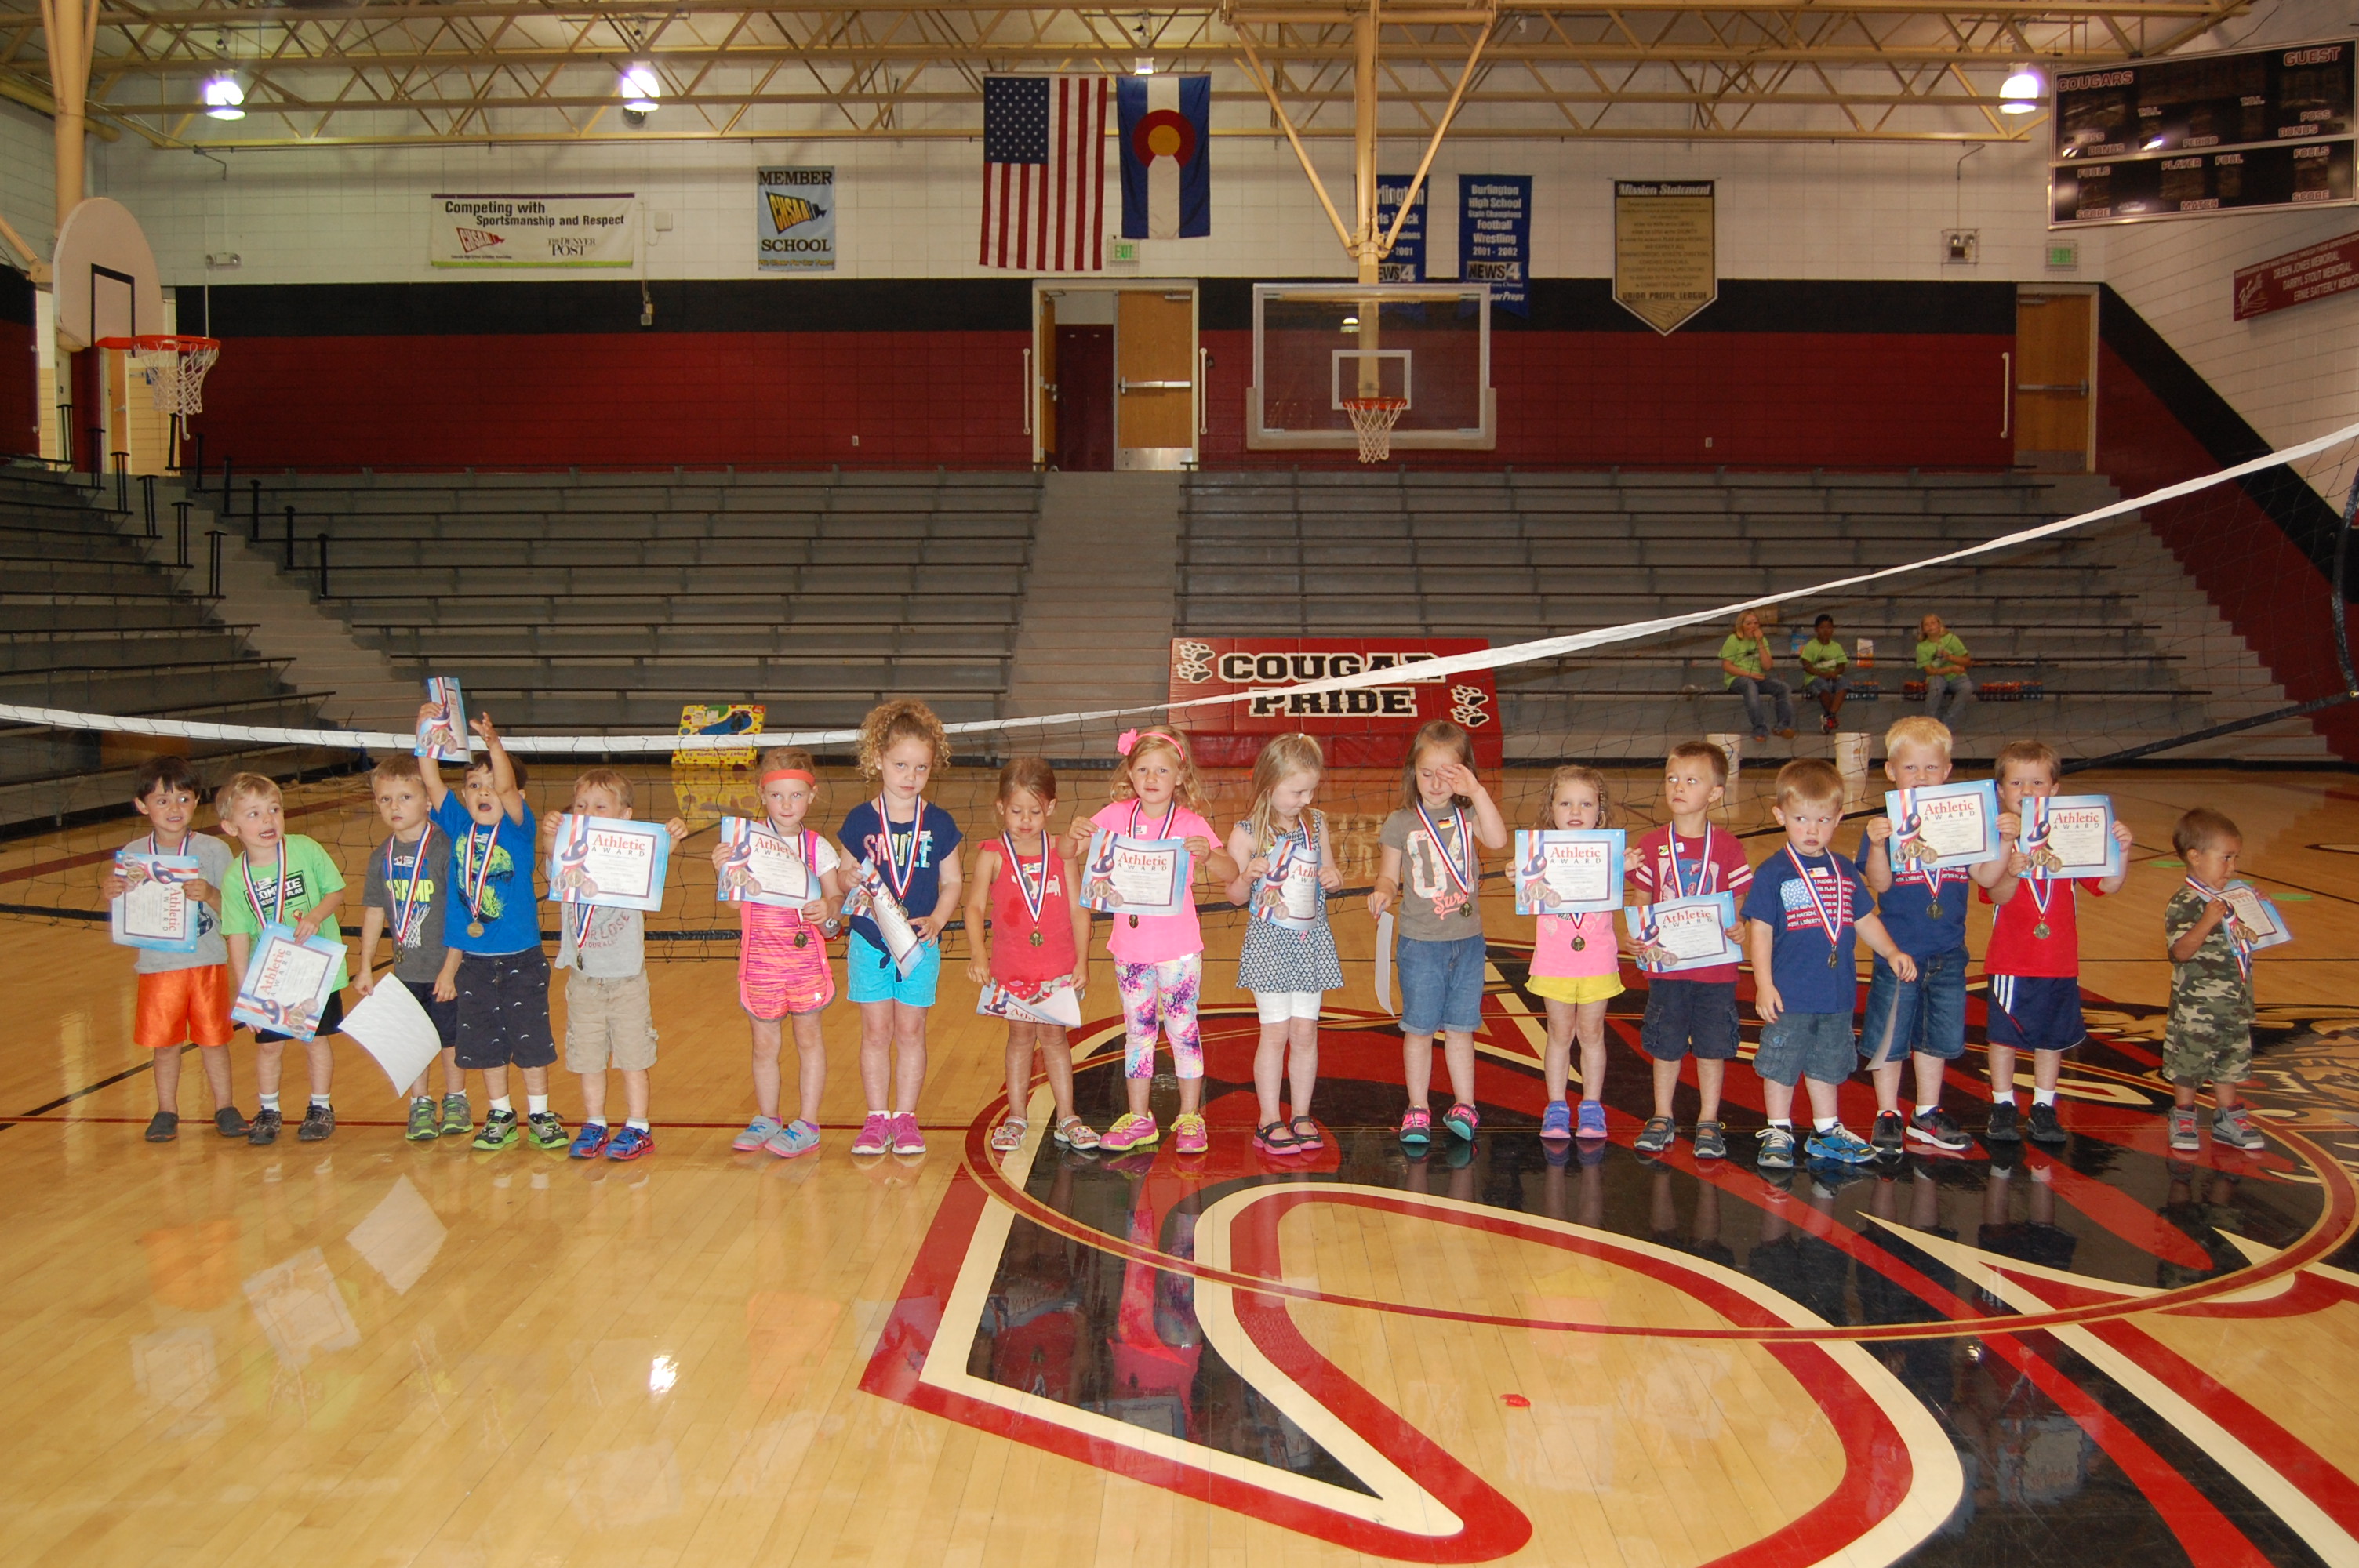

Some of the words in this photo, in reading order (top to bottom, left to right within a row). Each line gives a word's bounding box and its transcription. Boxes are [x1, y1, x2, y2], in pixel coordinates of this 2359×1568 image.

[2284, 46, 2341, 67] GUEST
[2058, 71, 2133, 92] COUGARS
[2300, 110, 2331, 122] POSS
[2278, 125, 2318, 138] BONUS
[2183, 136, 2219, 147] PERIOD
[2088, 143, 2125, 155] BONUS
[2294, 146, 2329, 158] FOULS
[2161, 158, 2202, 170] PLAYER
[2215, 154, 2244, 165] FOUL
[758, 171, 832, 185] MEMBER
[2077, 166, 2110, 178] FOULS
[1471, 184, 1519, 195] Burlington
[1619, 183, 1658, 196] Mission
[1659, 183, 1711, 196] Statement
[2292, 190, 2329, 201] SCORE
[445, 201, 513, 216] Competing
[518, 201, 545, 213] with
[1468, 198, 1489, 209] High
[1490, 198, 1521, 209] School
[2181, 199, 2219, 211] MATCH
[769, 194, 810, 231] CHSAA
[2076, 208, 2110, 220] SCORE
[476, 215, 555, 228] Sportsmanship
[559, 215, 579, 226] and
[583, 214, 624, 227] Respect
[1478, 220, 1513, 230] Football
[561, 237, 595, 245] DENVER
[761, 238, 831, 252] SCHOOL
[1473, 233, 1517, 245] Wrestling
[552, 244, 583, 256] POST
[2310, 250, 2339, 267] MEMORIAL
[2322, 261, 2352, 279] MEMORIAL
[1249, 687, 1417, 717] PRIDE
[1924, 800, 1975, 815] Athletic
[2053, 811, 2099, 824] Athletic
[592, 834, 645, 851] Athletic
[1118, 852, 1168, 866] Athletic
[1550, 846, 1601, 858] Athletic
[169, 887, 182, 931] Athletic
[1431, 891, 1469, 920] Sur
[1663, 910, 1712, 924] Athletic
[600, 911, 630, 939] LOSE
[260, 948, 286, 996] Athletic
